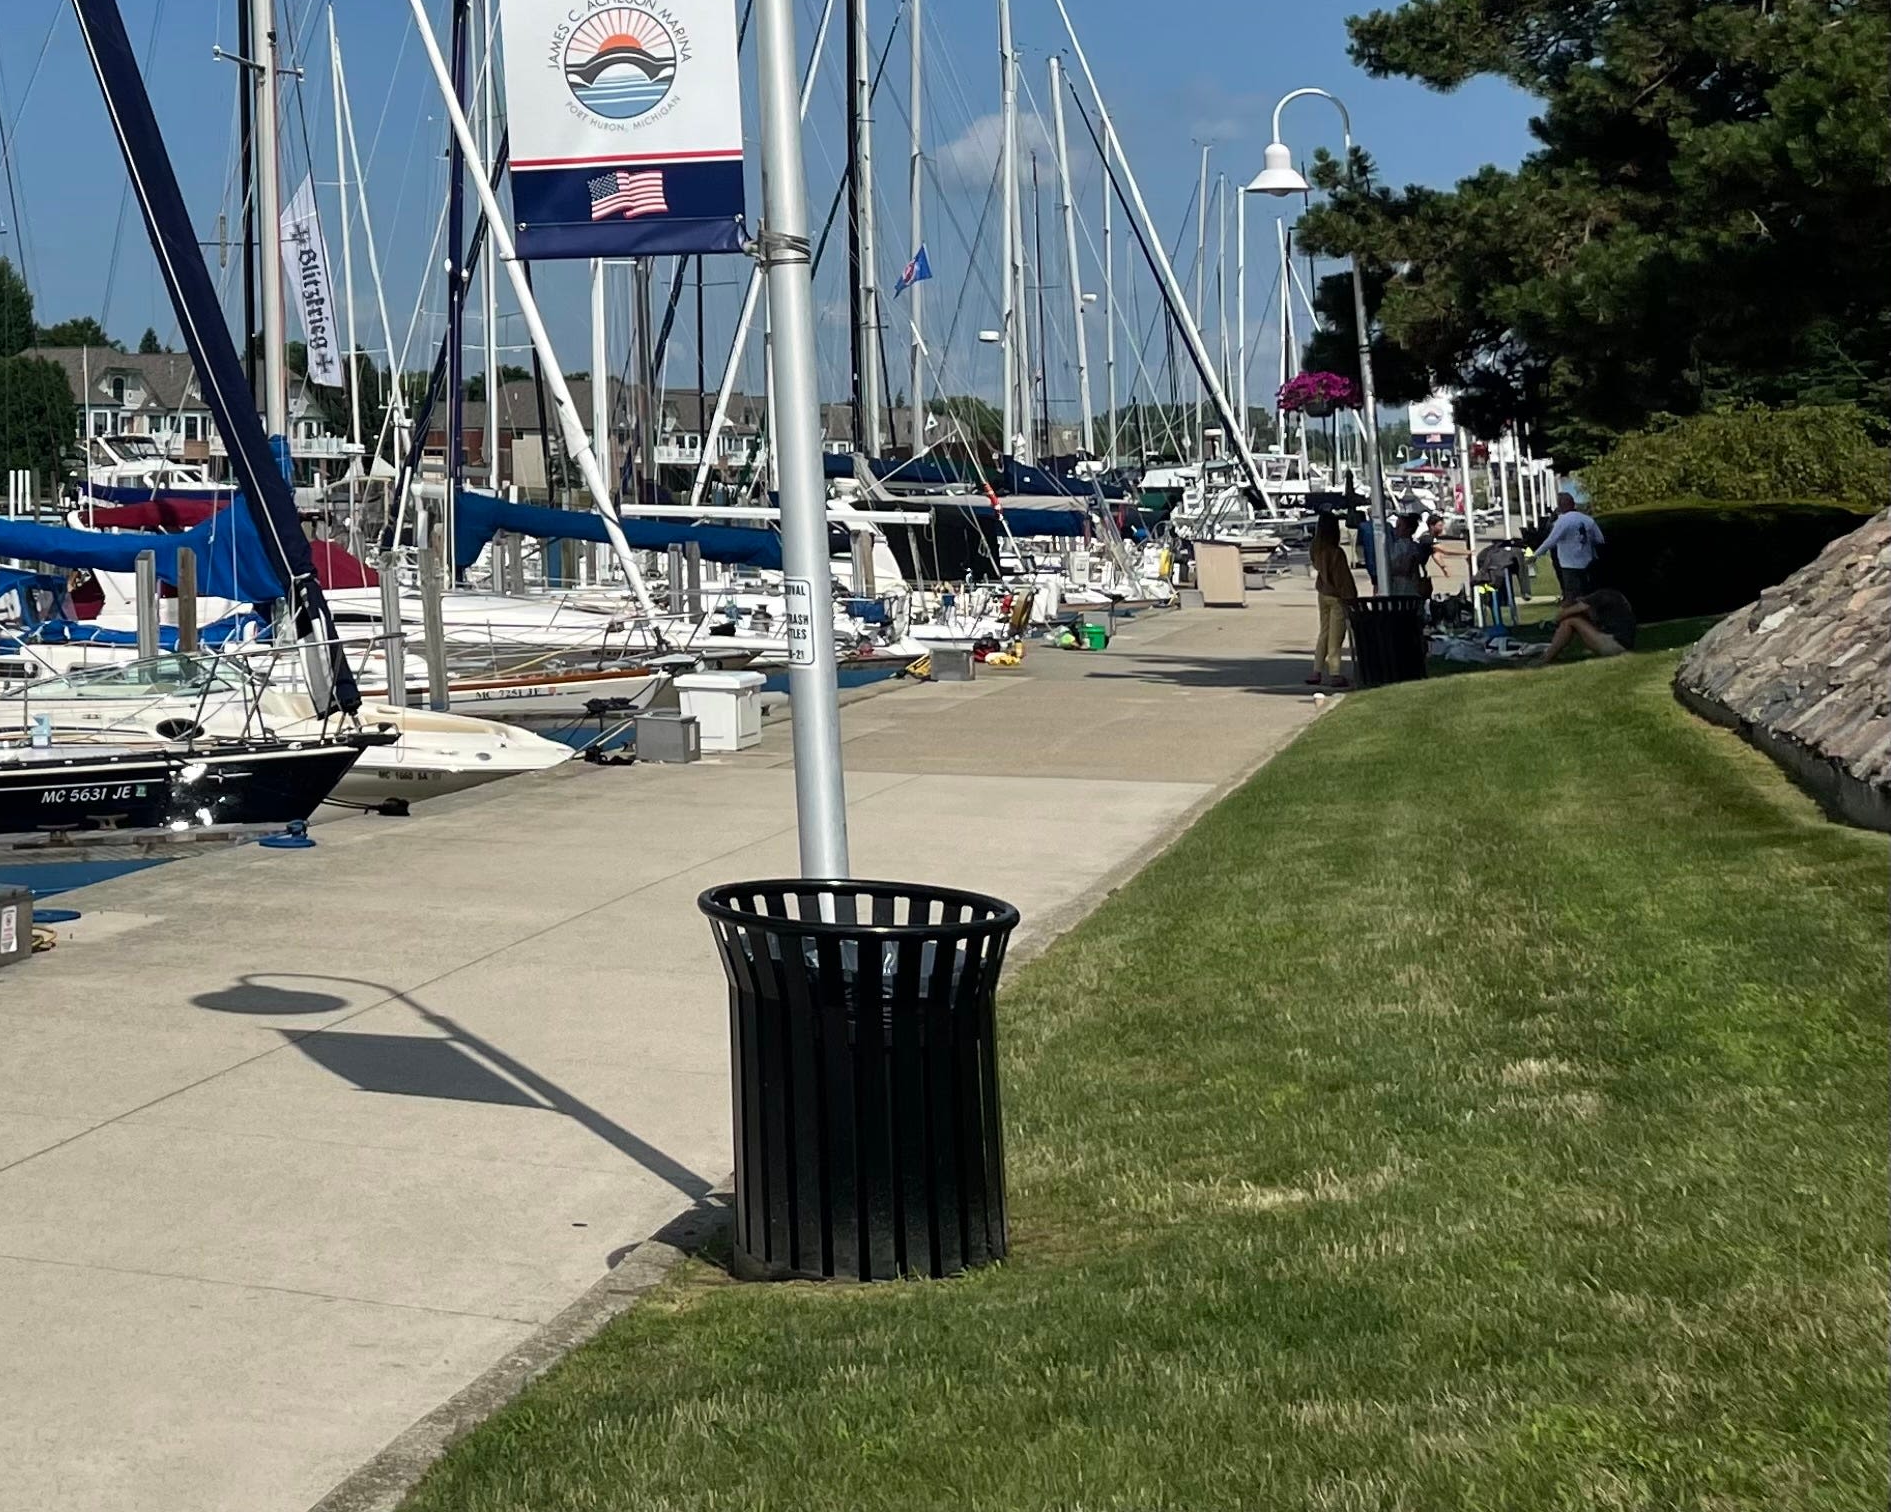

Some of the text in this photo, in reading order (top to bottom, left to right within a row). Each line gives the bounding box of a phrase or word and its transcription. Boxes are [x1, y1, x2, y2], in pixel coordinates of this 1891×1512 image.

[548, 23, 570, 70] JAMES
[657, 8, 693, 63] MARINA
[565, 101, 588, 121] PORT
[632, 94, 681, 130] MICHIGAN
[1279, 494, 1306, 505] 475
[41, 789, 66, 804] MC
[70, 787, 108, 802] 5631
[112, 785, 132, 800] JE
